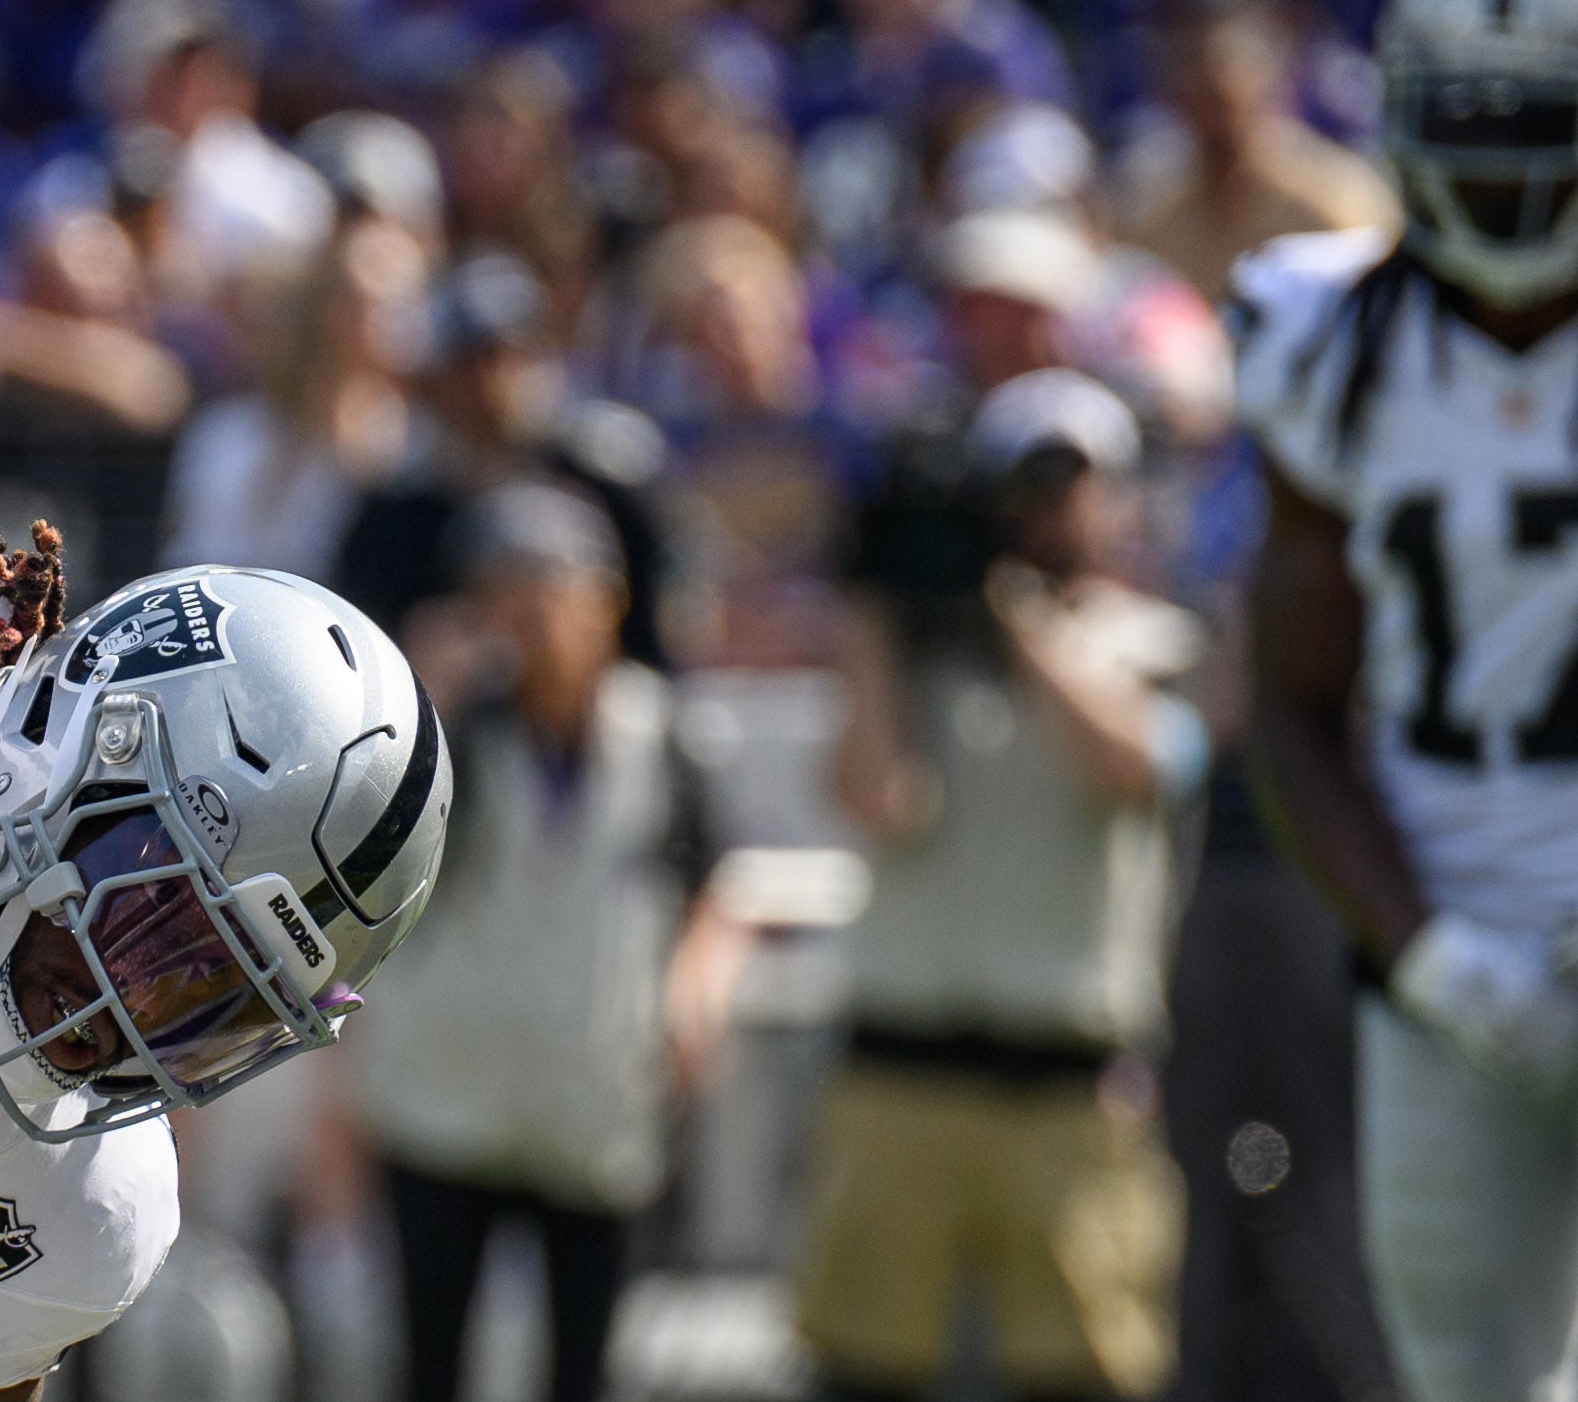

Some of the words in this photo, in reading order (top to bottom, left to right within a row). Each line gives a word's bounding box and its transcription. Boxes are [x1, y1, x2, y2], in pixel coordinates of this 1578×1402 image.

[177, 584, 215, 652] RAIDERS
[178, 782, 224, 846] OAKLEY
[268, 893, 326, 969] RAIDERS
